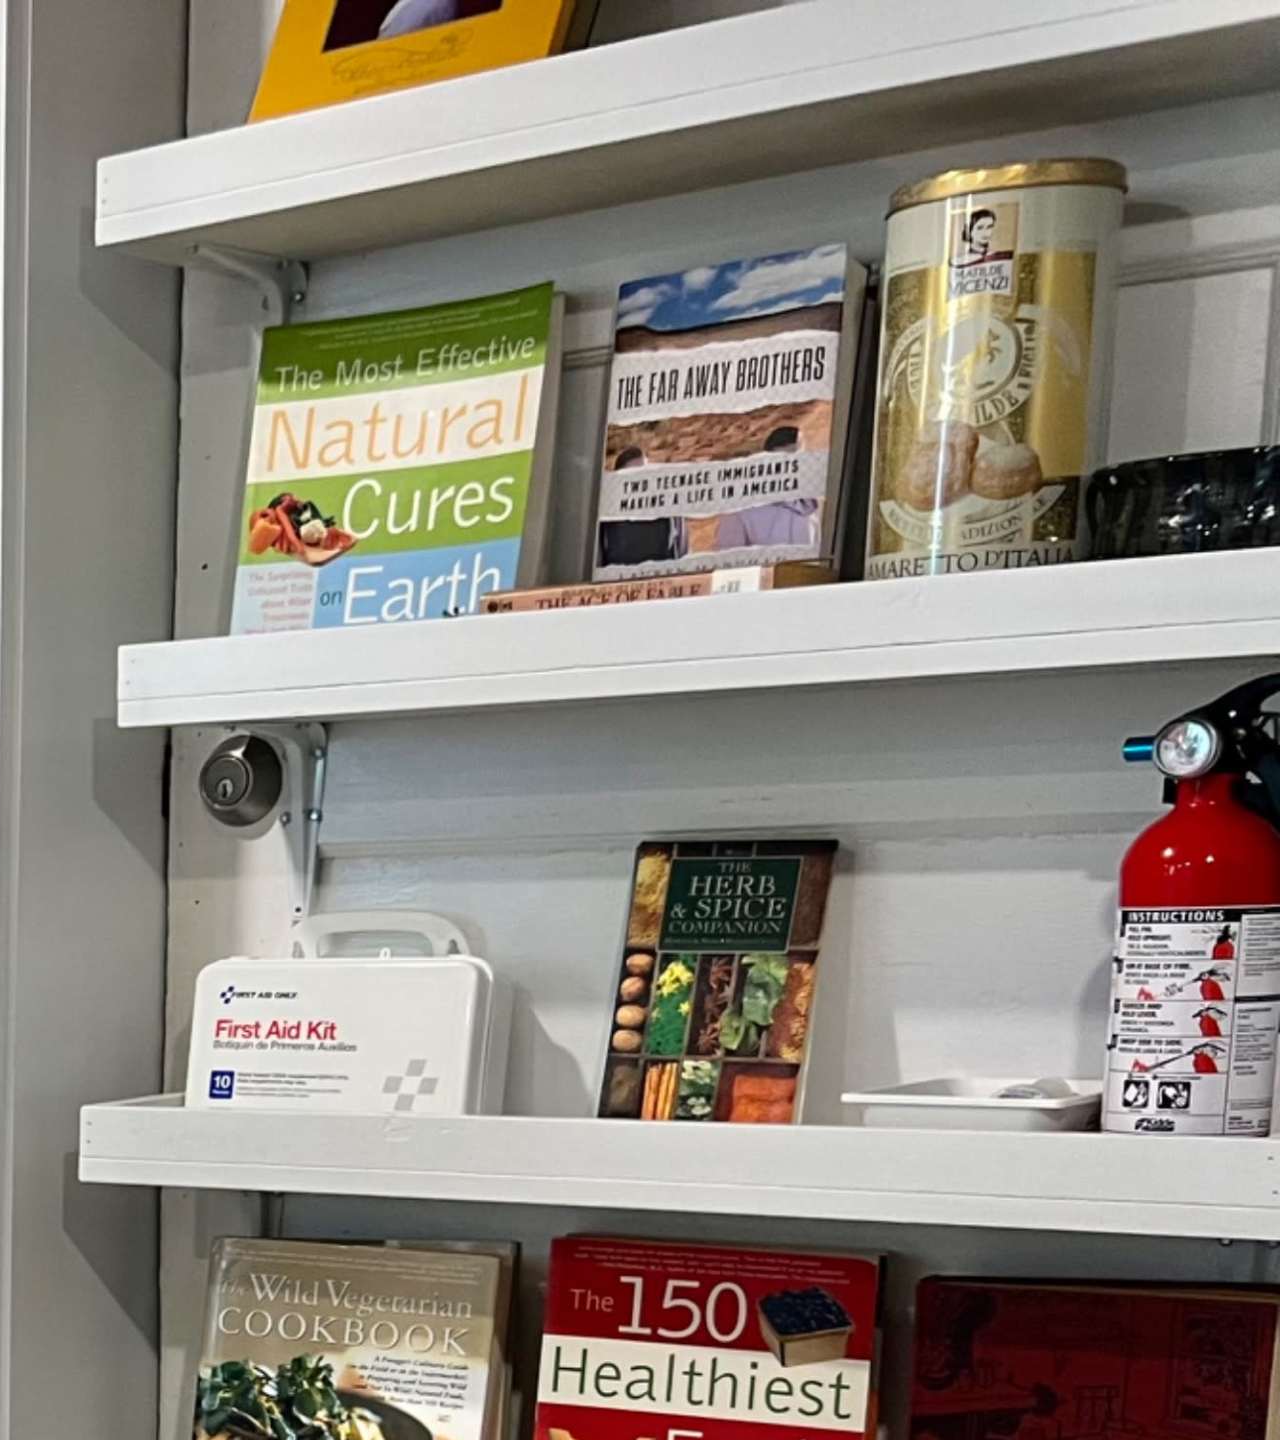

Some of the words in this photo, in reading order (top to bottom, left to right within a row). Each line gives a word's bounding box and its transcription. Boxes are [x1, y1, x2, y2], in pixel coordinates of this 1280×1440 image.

[274, 363, 324, 393] The
[335, 358, 403, 388] Most
[416, 333, 536, 376] Effective
[616, 374, 644, 411] THE
[648, 368, 680, 406] FAR
[683, 359, 732, 399] AWAY
[735, 346, 826, 393] BROTHERS
[265, 373, 529, 473] Natural
[618, 495, 666, 512] MAKING
[672, 494, 680, 505] A
[686, 487, 715, 504] LIFE
[721, 485, 736, 499] IN
[741, 477, 800, 497] AMERICA
[622, 480, 649, 495] TWO
[655, 471, 711, 490] TEENAGE
[717, 459, 801, 483] IMMIGRANTS
[341, 476, 516, 541] Cures
[319, 591, 343, 607] on
[343, 551, 502, 625] Earth
[687, 874, 777, 897] HERB
[717, 860, 753, 874] THE
[667, 919, 783, 934] COMPANION
[669, 903, 688, 919] &
[693, 896, 789, 920] SPICE
[1127, 910, 1226, 923] INSTRUCTIONS
[214, 1018, 262, 1039] First
[265, 1019, 302, 1040] Aid
[306, 1020, 338, 1041] Kit
[213, 1075, 232, 1089] 10
[249, 1272, 320, 1307] Wild
[325, 1279, 473, 1319] Vegetarian
[570, 1288, 615, 1314] The
[617, 1275, 749, 1343] 150
[218, 1306, 470, 1356] COOKBOOK
[551, 1345, 853, 1421] Healthiest
